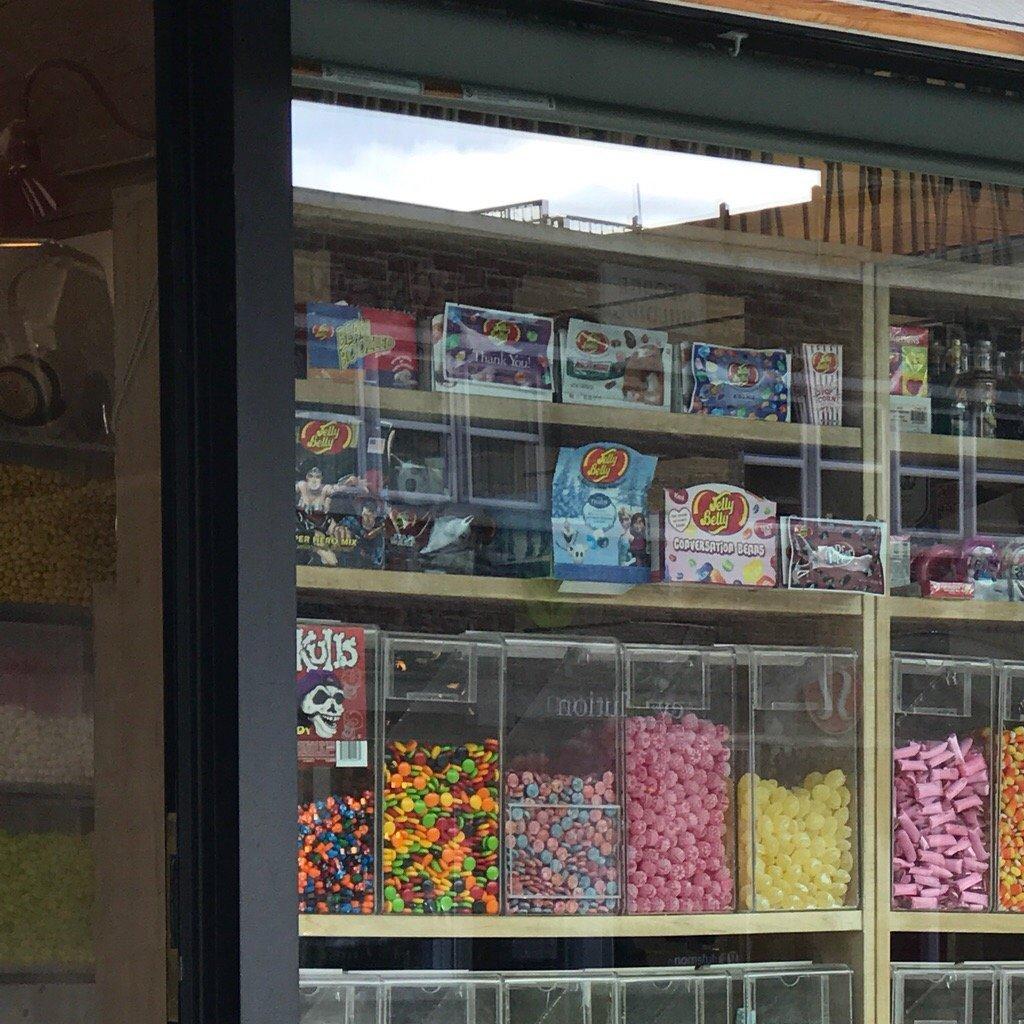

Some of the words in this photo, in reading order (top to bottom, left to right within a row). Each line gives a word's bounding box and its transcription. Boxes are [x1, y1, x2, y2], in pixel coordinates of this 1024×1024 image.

[475, 350, 507, 366] Thank
[509, 353, 531, 368] You!
[709, 493, 735, 516] Jelly
[700, 511, 729, 529] Belly
[295, 534, 311, 543] ER
[339, 537, 359, 547] MIX
[673, 536, 736, 554] CONVERSATION
[296, 627, 358, 672] kulls
[296, 725, 310, 736] DY
